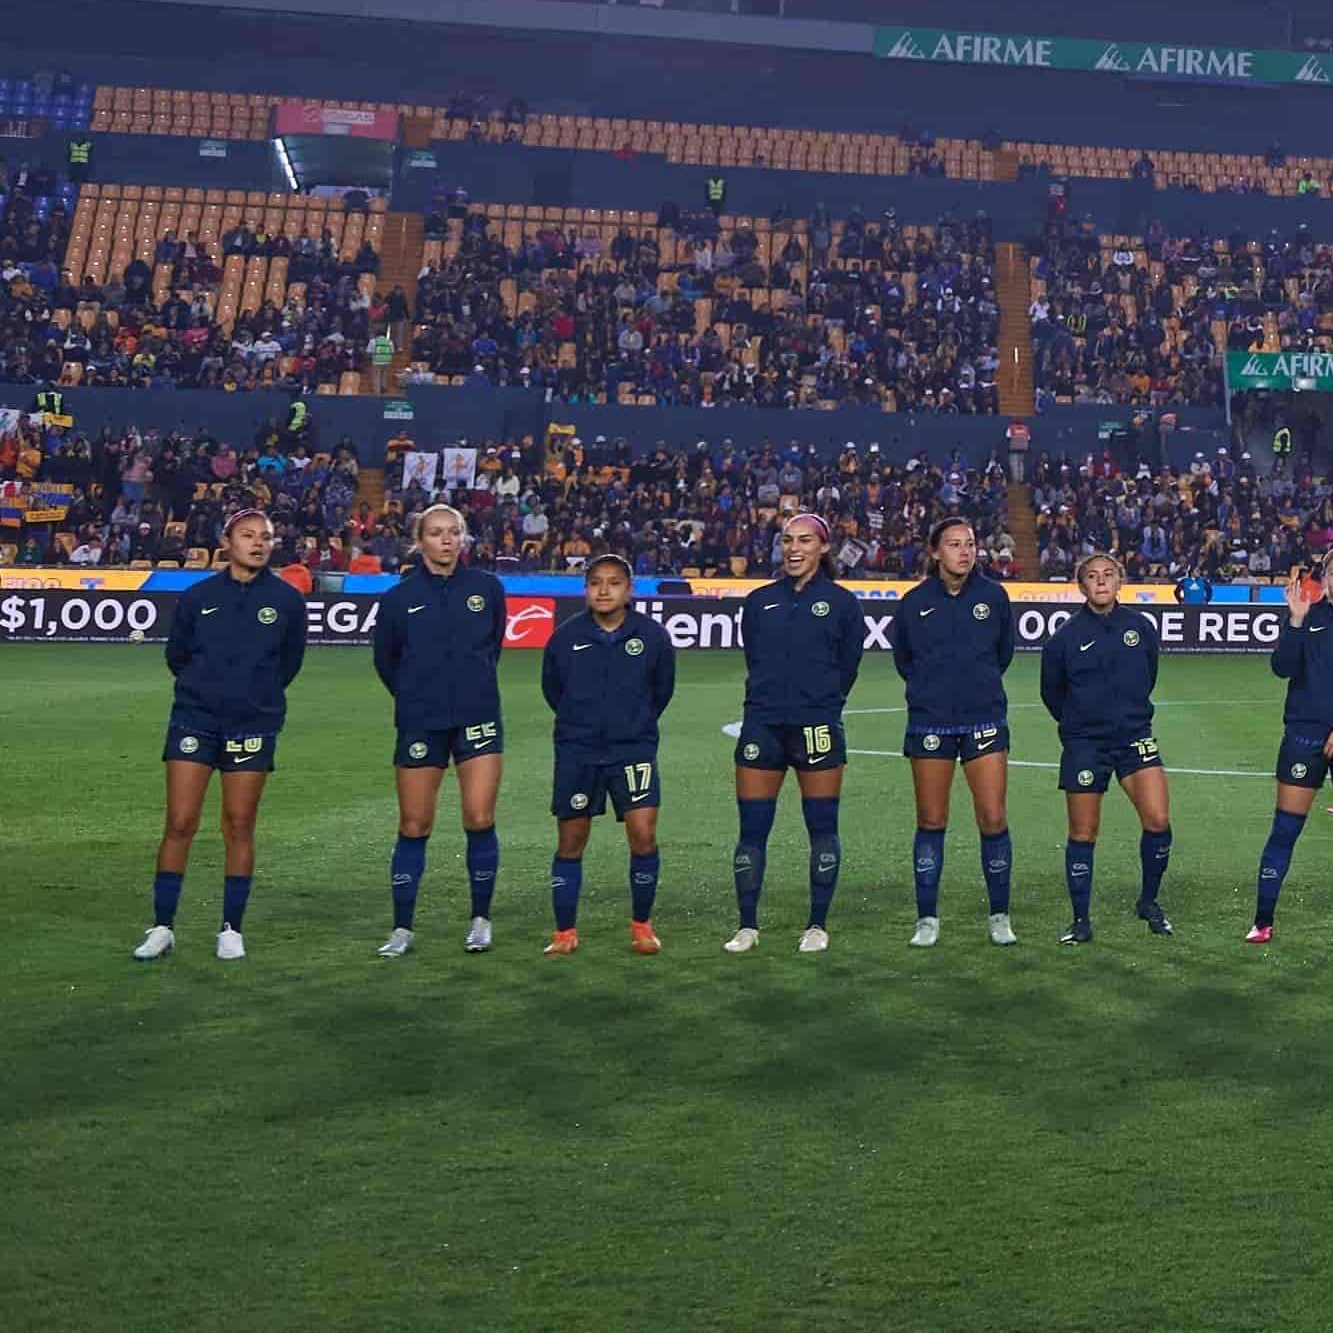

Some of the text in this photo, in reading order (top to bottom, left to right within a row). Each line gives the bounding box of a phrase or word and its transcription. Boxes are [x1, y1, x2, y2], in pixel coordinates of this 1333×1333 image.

[932, 33, 1053, 66] AFIRME
[1137, 46, 1252, 78] AFIRME
[0, 595, 157, 636] $1,000
[802, 725, 831, 755] 16
[623, 762, 652, 793] 17
